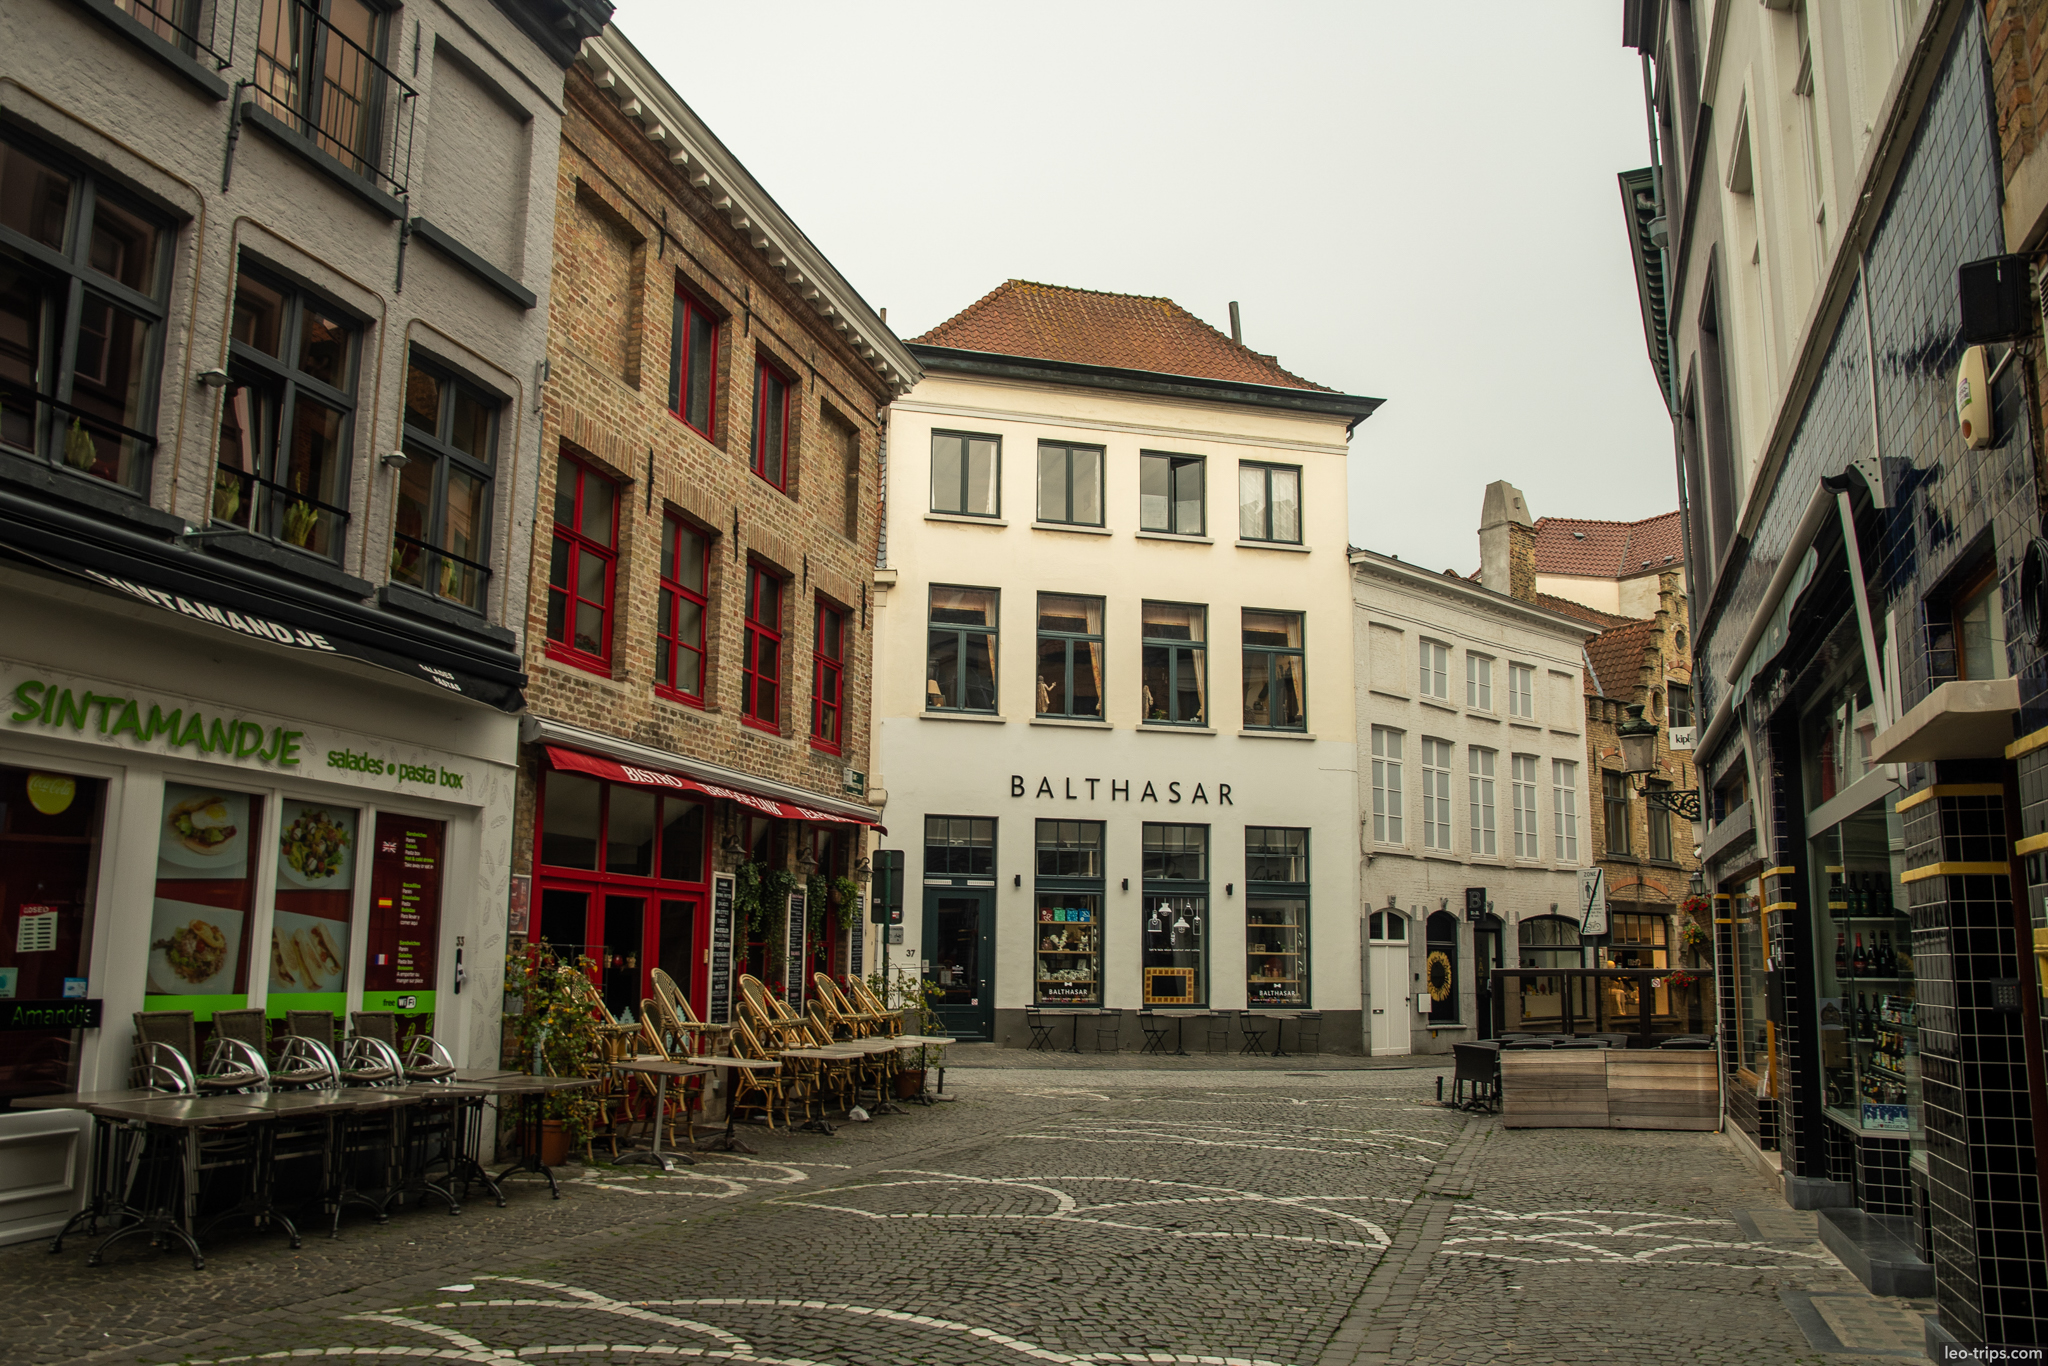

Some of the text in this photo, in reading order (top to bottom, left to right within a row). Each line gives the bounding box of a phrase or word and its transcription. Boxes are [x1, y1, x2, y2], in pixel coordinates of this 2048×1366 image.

[12, 680, 304, 764] SINTAMANDJE
[327, 748, 464, 789] salades pasta box
[620, 765, 683, 788] BISTRO
[28, 774, 76, 796] Coca-Cola
[1010, 774, 1234, 806] BALTHASAR
[1468, 891, 1482, 909] B
[456, 936, 466, 946] 33
[905, 949, 916, 958] 37
[383, 998, 395, 1006] free
[11, 1004, 92, 1028] Amandje
